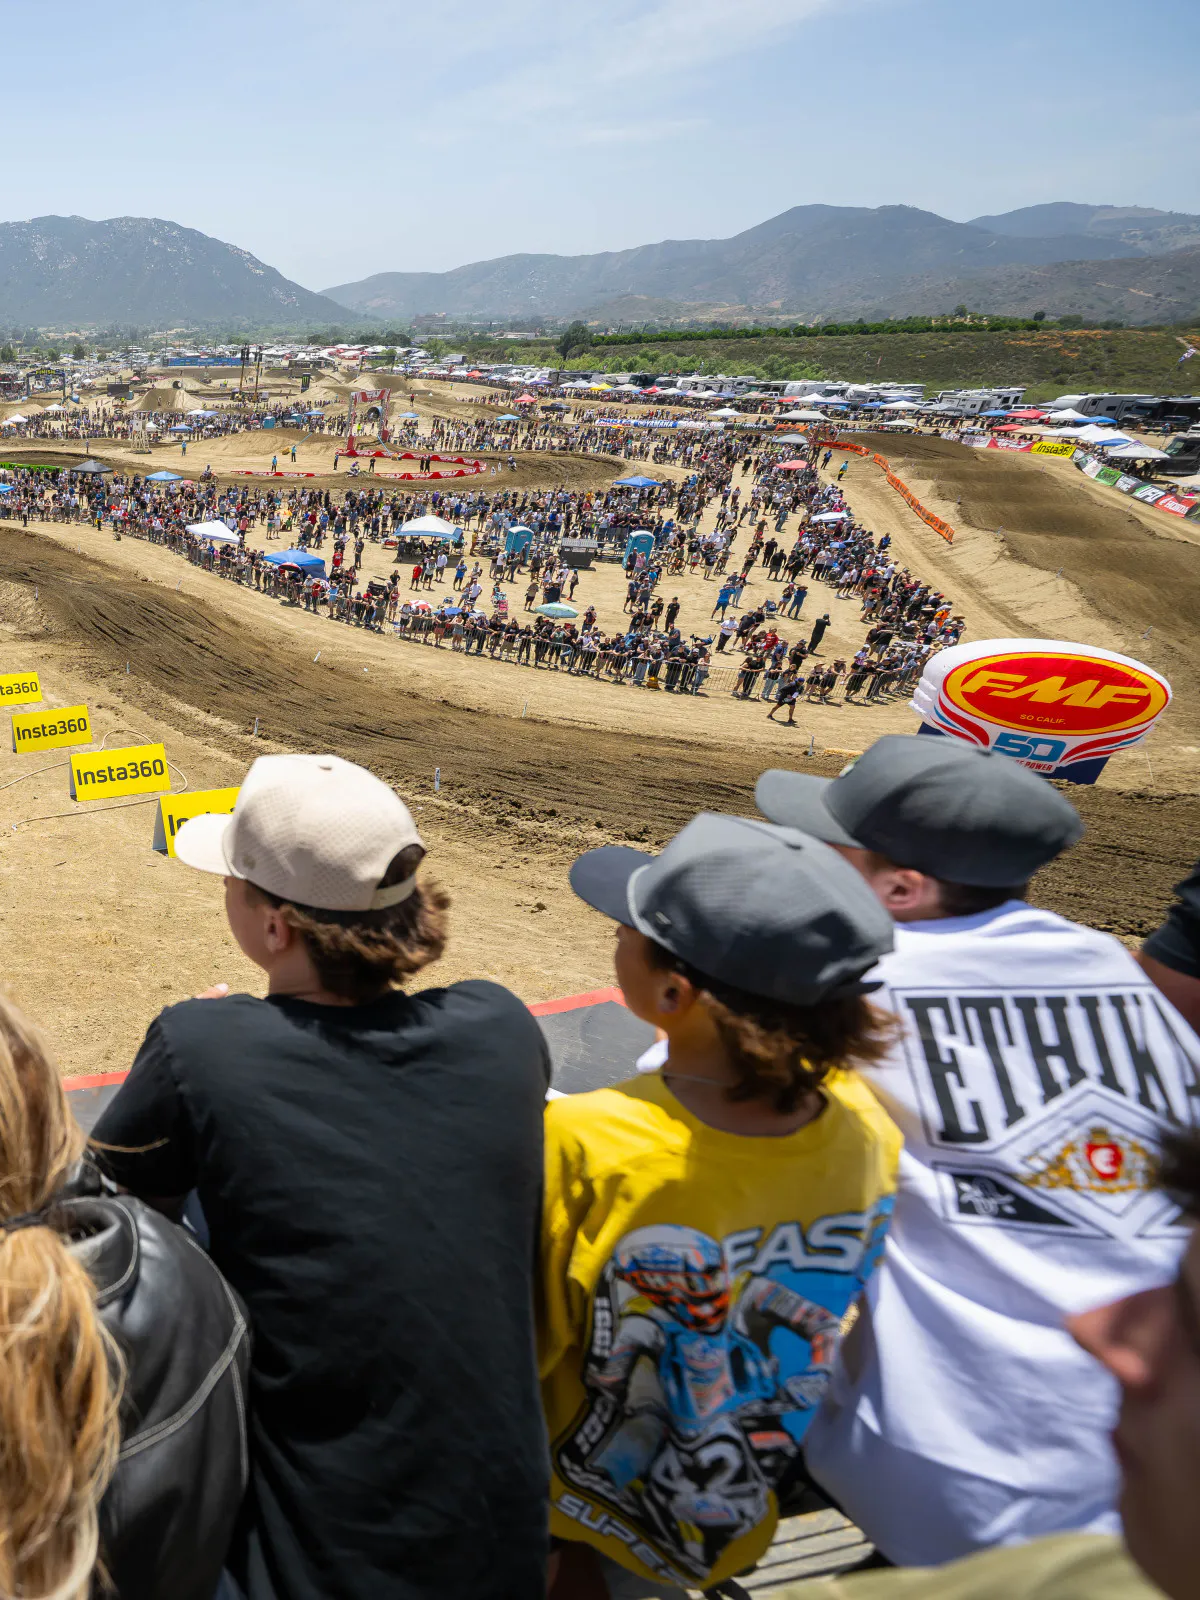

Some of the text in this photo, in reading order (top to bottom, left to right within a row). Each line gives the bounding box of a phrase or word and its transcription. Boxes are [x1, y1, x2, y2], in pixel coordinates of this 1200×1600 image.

[960, 670, 1150, 709] FMF
[16, 717, 88, 741] Insta360
[992, 732, 1067, 763] 50
[76, 758, 166, 786] Insta360
